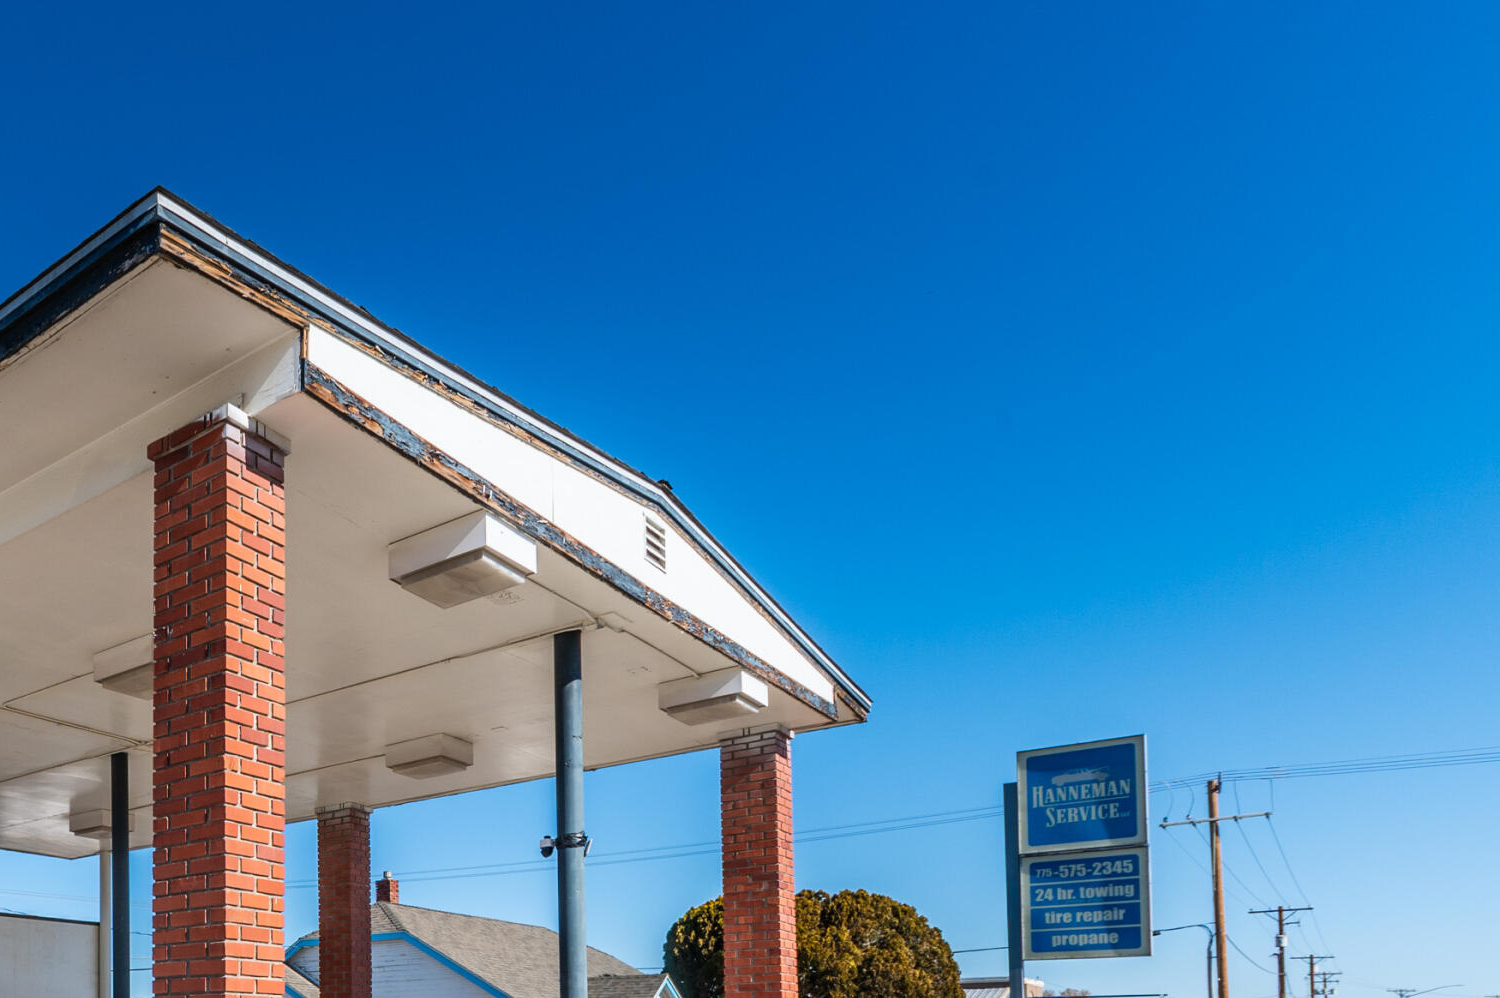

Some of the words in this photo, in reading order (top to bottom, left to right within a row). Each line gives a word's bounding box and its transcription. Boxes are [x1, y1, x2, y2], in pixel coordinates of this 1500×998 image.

[1032, 778, 1131, 808] HANNEMAN
[1045, 802, 1119, 828] SERVICE
[1035, 860, 1133, 878] 775-575-2345
[1035, 888, 1054, 902] 24
[1057, 887, 1076, 900] hr.
[1080, 883, 1134, 898] towing
[1045, 911, 1072, 924] tire
[1076, 907, 1126, 923] repair
[1052, 932, 1119, 947] propane
